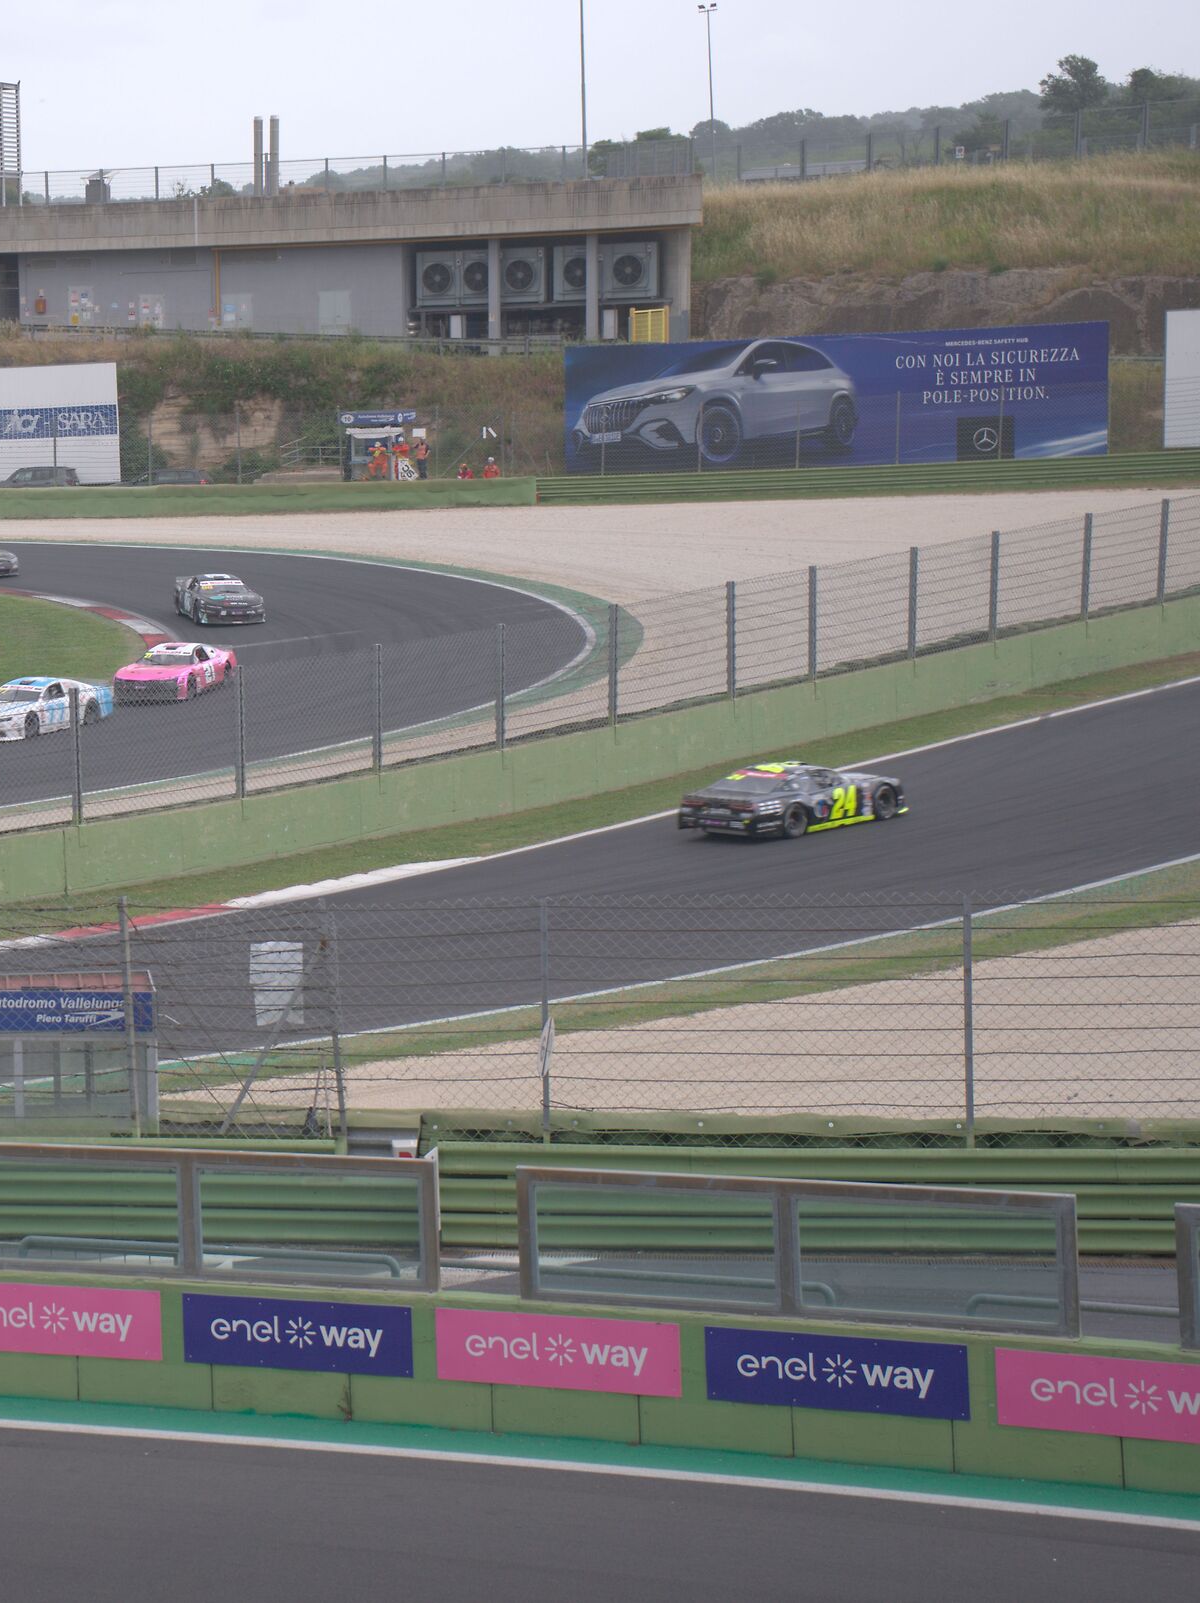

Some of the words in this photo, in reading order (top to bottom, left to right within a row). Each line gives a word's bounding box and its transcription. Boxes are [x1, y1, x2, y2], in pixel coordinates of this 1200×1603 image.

[896, 355, 926, 369] CON
[933, 353, 960, 367] NOI
[966, 352, 986, 366] LA
[990, 348, 1080, 365] SICUREZZA
[936, 369, 944, 386] È
[950, 368, 1013, 384] SEMPRE
[1020, 368, 1036, 382] IN
[923, 386, 1049, 404] POLE-POSTION.
[58, 412, 108, 430] SARA
[829, 784, 857, 820] 24
[36, 1014, 62, 1023] Piero
[64, 1014, 97, 1023] Taruffi
[72, 1311, 133, 1342] way
[210, 1316, 281, 1343] enel
[319, 1324, 383, 1358] way
[465, 1332, 539, 1360] enel
[580, 1342, 648, 1376] way
[736, 1352, 817, 1382] enel
[861, 1364, 934, 1399] way
[1030, 1376, 1118, 1408] enel
